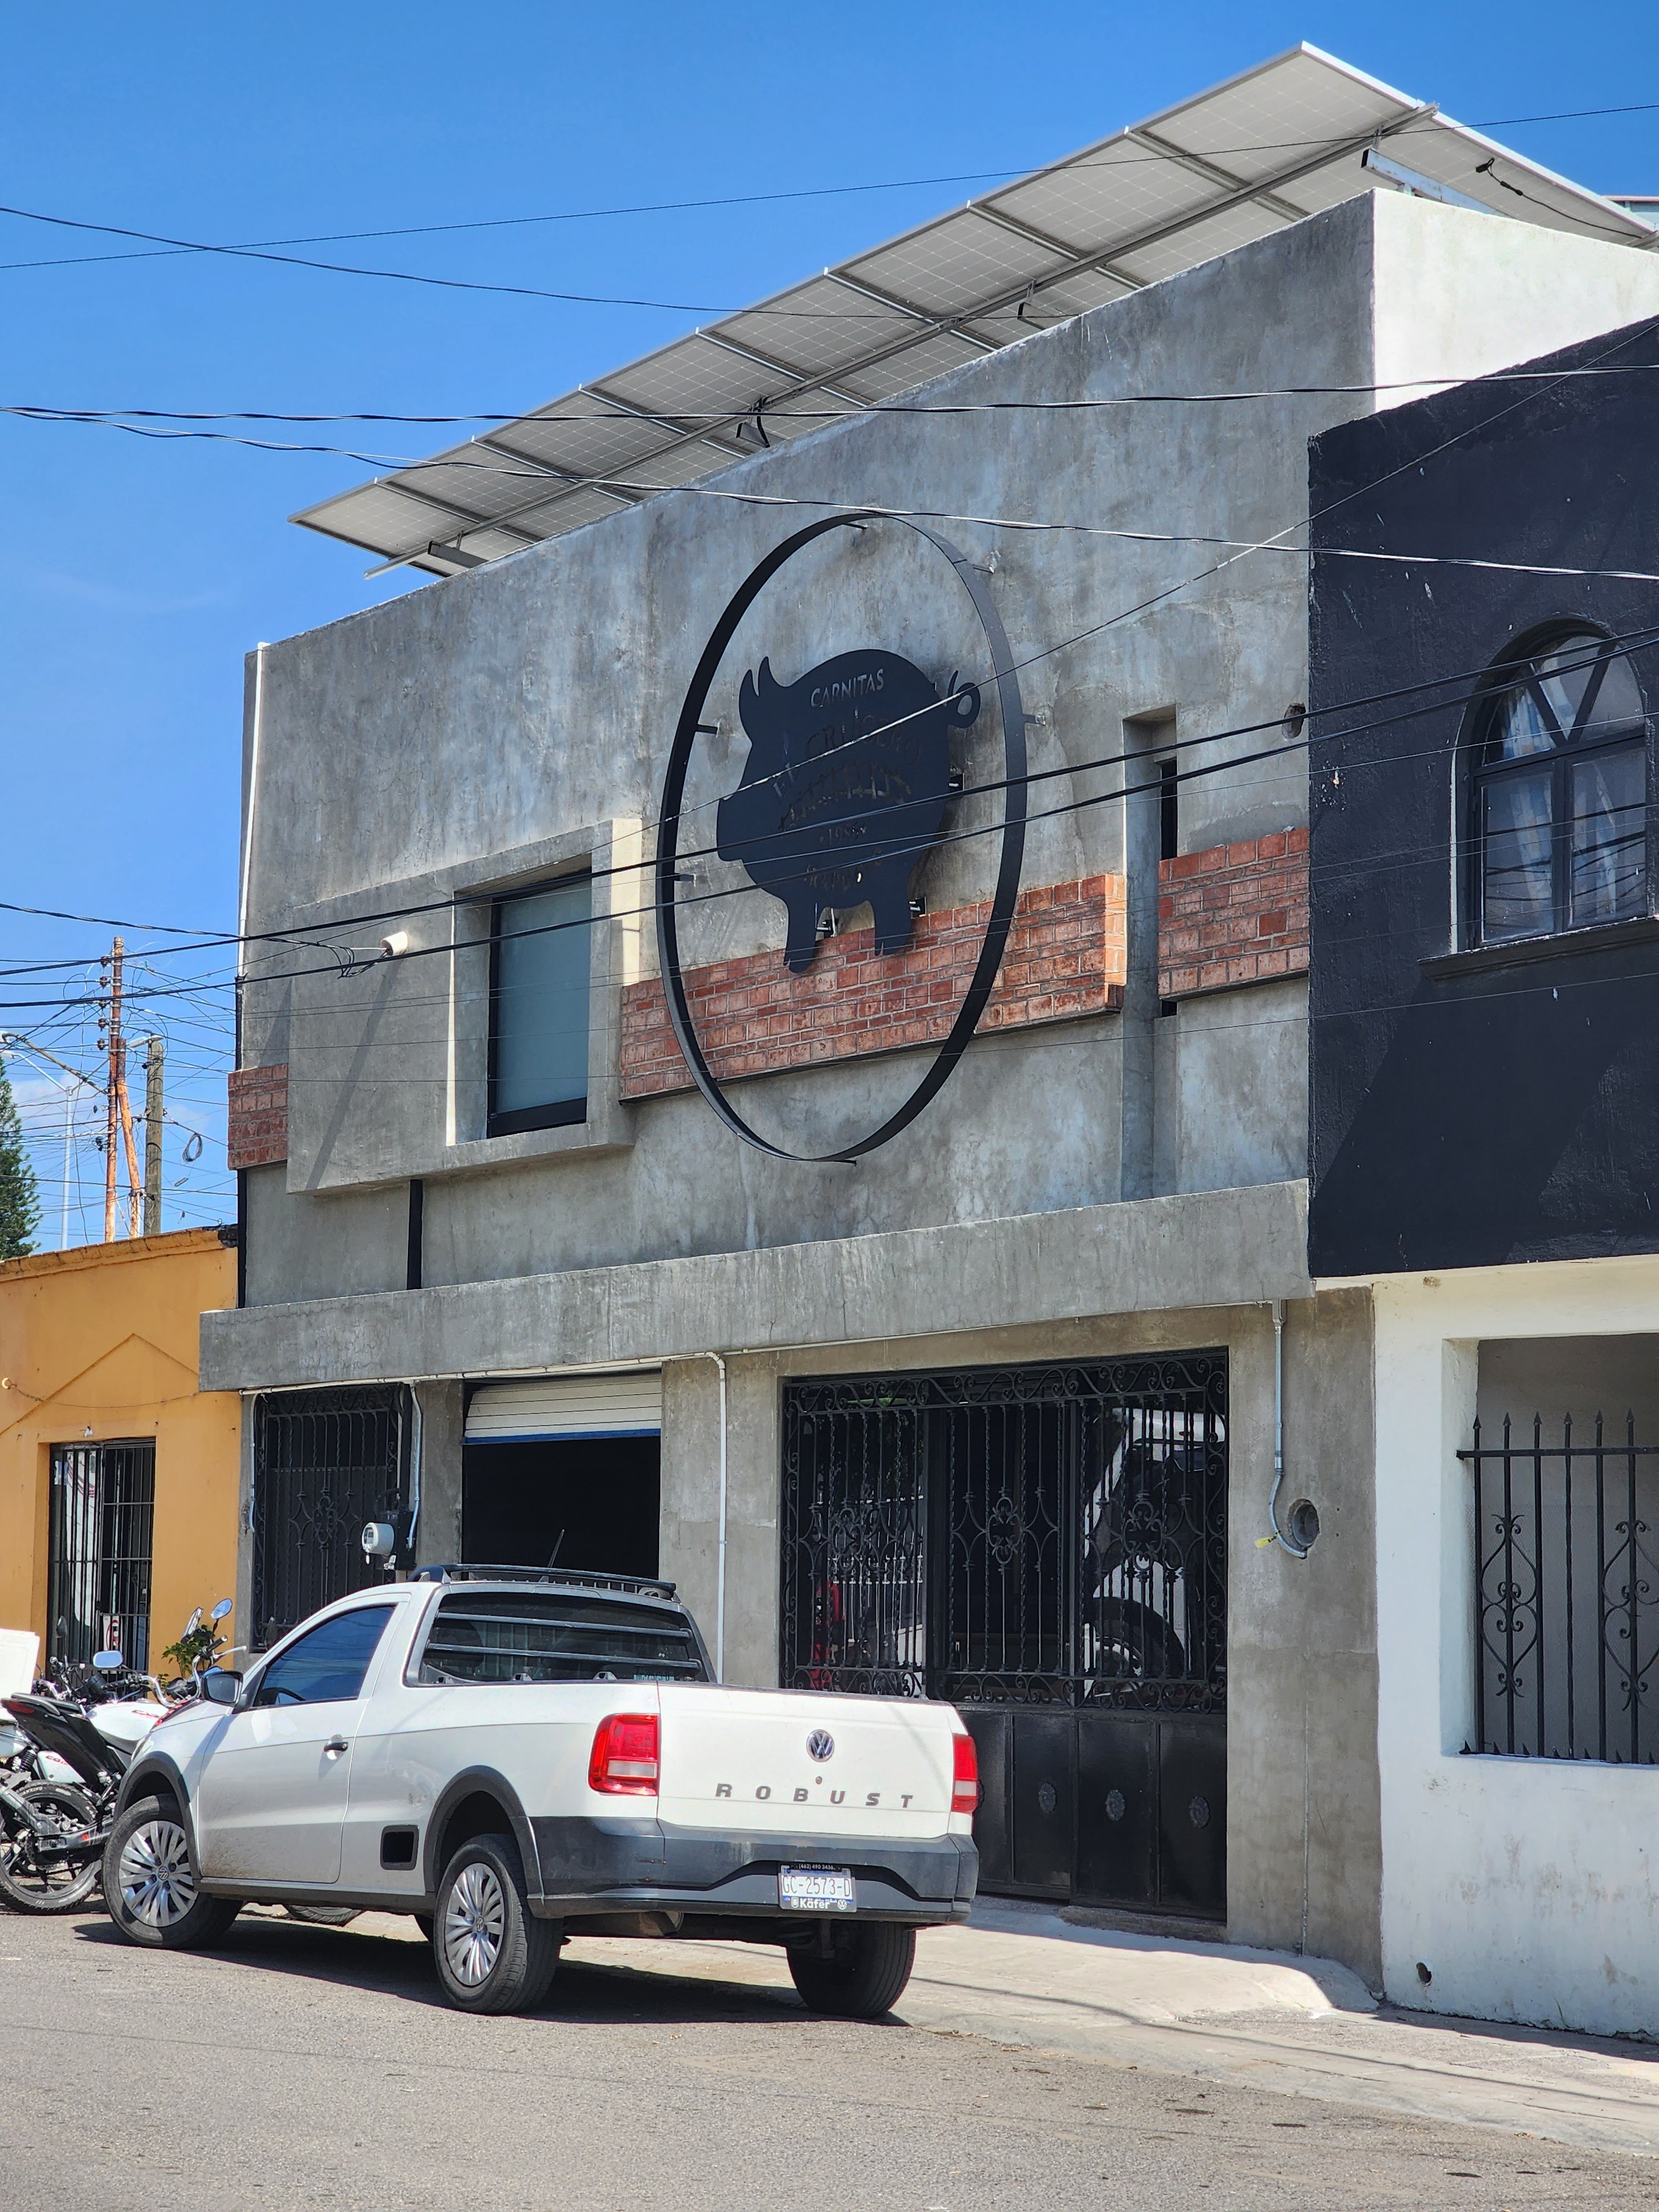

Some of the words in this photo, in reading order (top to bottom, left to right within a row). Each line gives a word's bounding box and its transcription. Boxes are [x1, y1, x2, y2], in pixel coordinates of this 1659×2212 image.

[810, 667, 885, 708] CARNITAS
[715, 1783, 913, 1808] ROBUST
[782, 1875, 851, 1897] GC-2573-D
[800, 1897, 830, 1909] Käfer
